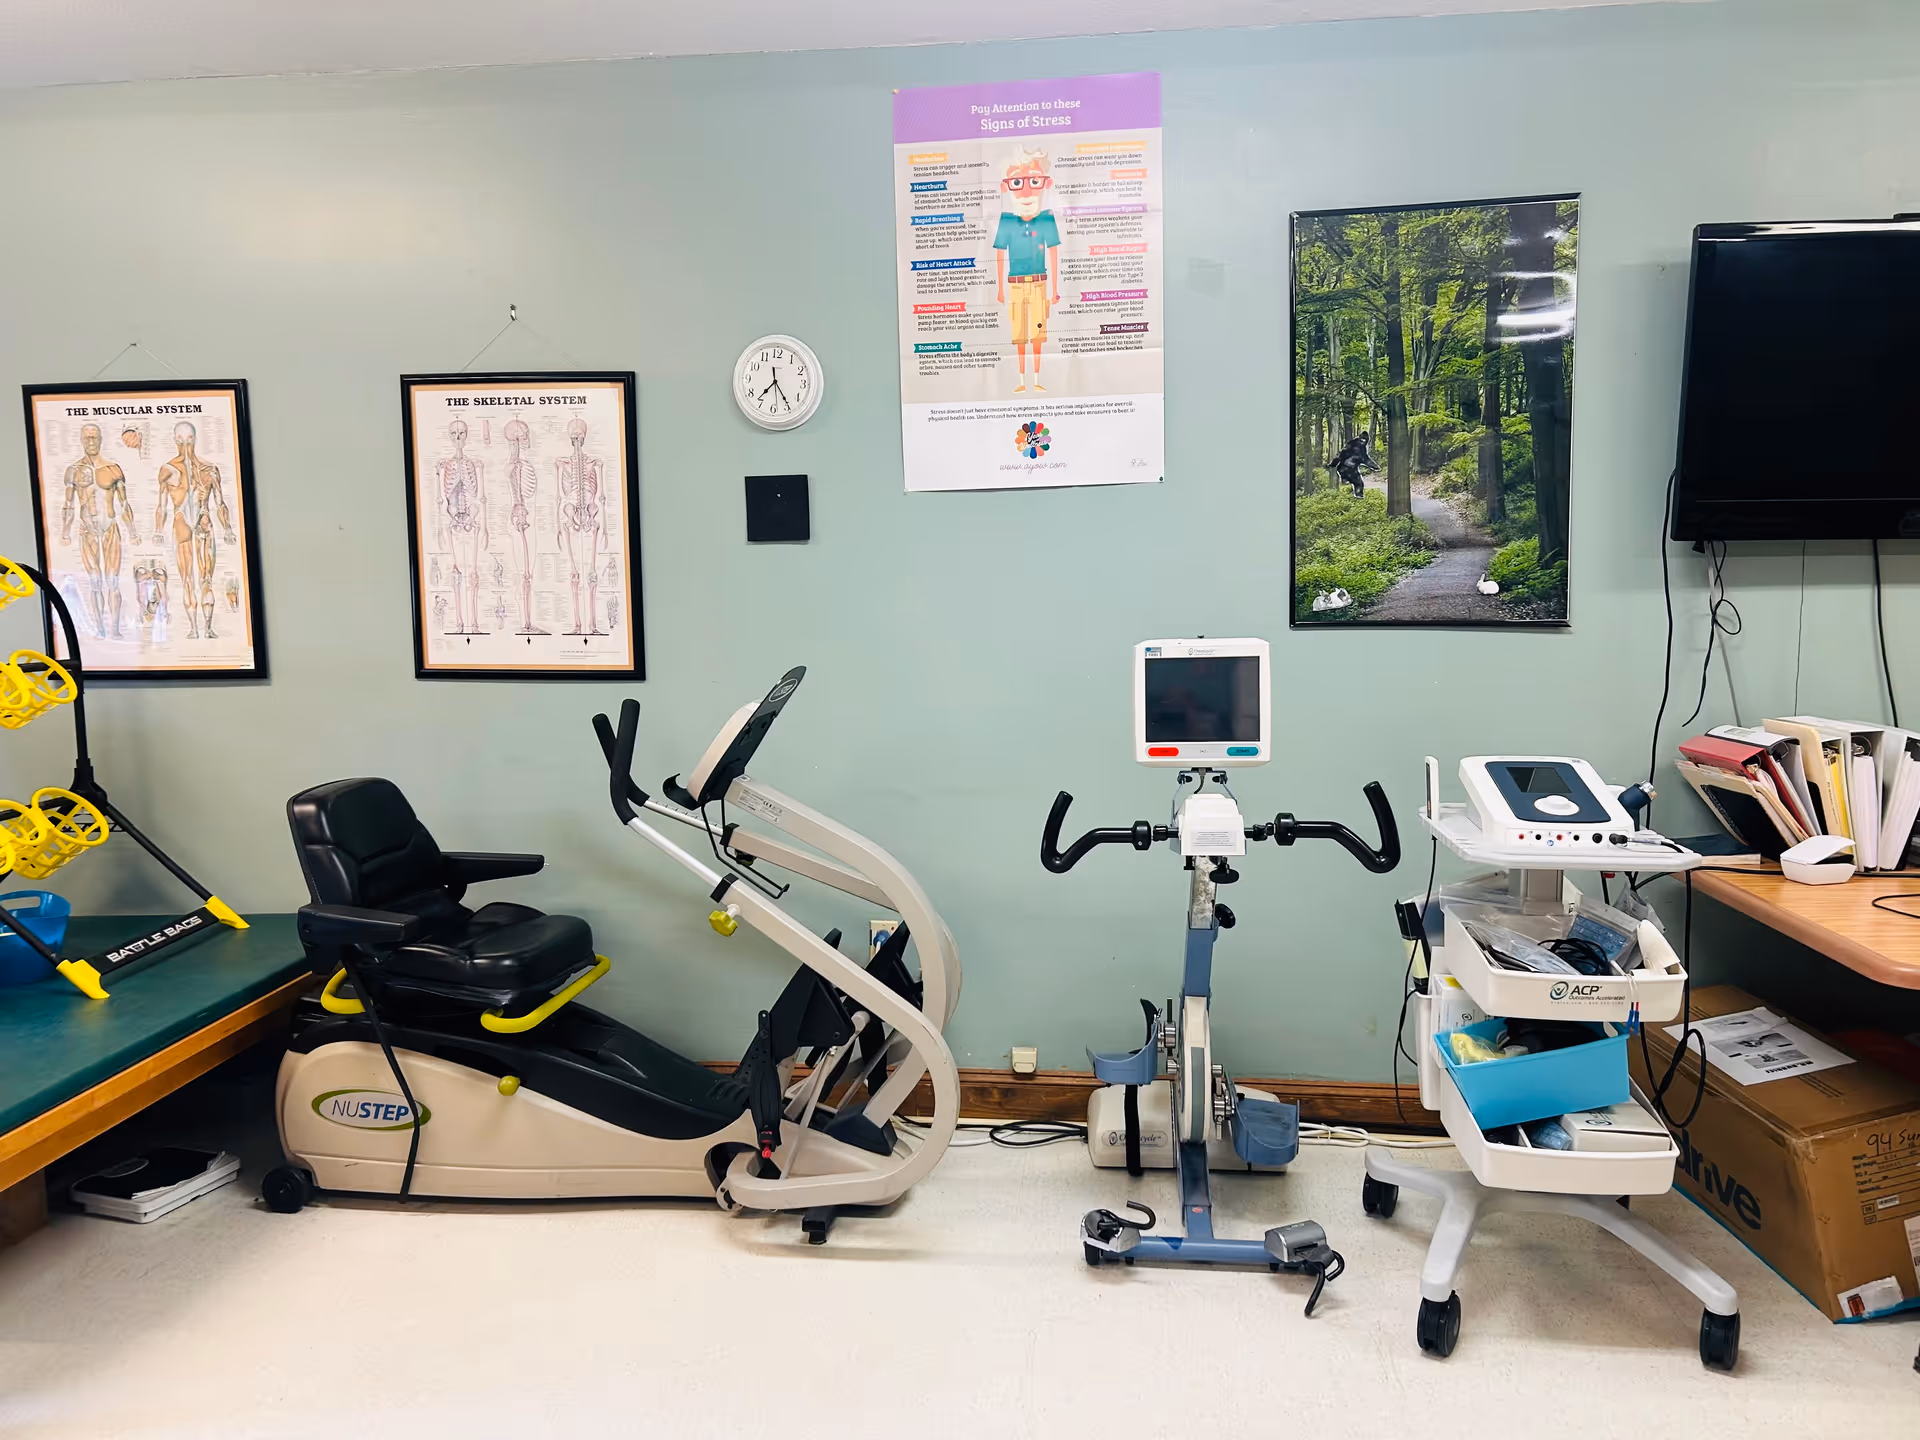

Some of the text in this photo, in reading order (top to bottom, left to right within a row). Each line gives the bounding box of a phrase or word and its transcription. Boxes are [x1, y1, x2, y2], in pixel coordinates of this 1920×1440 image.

[970, 105, 990, 115] Pay
[992, 102, 1039, 113] Attention
[1054, 99, 1081, 109] these
[980, 116, 1071, 132] Signs of Stress
[932, 216, 961, 224] Breathing
[761, 352, 769, 362] 11
[772, 349, 783, 358] 12
[790, 355, 793, 364] 1
[750, 362, 760, 371] 10
[798, 366, 804, 375] 2
[745, 374, 751, 383] 9
[800, 380, 806, 389] 3
[748, 388, 754, 397] 8
[445, 396, 587, 406] THE SKELETAL SYSTEM
[757, 399, 764, 408] 7
[65, 405, 202, 416] THE MUSCULAR SYSTEM
[770, 404, 777, 413] 6
[784, 402, 791, 411] 5
[106, 916, 203, 963] BATTLE BAGS
[1570, 985, 1600, 995] ACP
[332, 1100, 409, 1121] NUSTEP
[1866, 1133, 1892, 1156] 94
